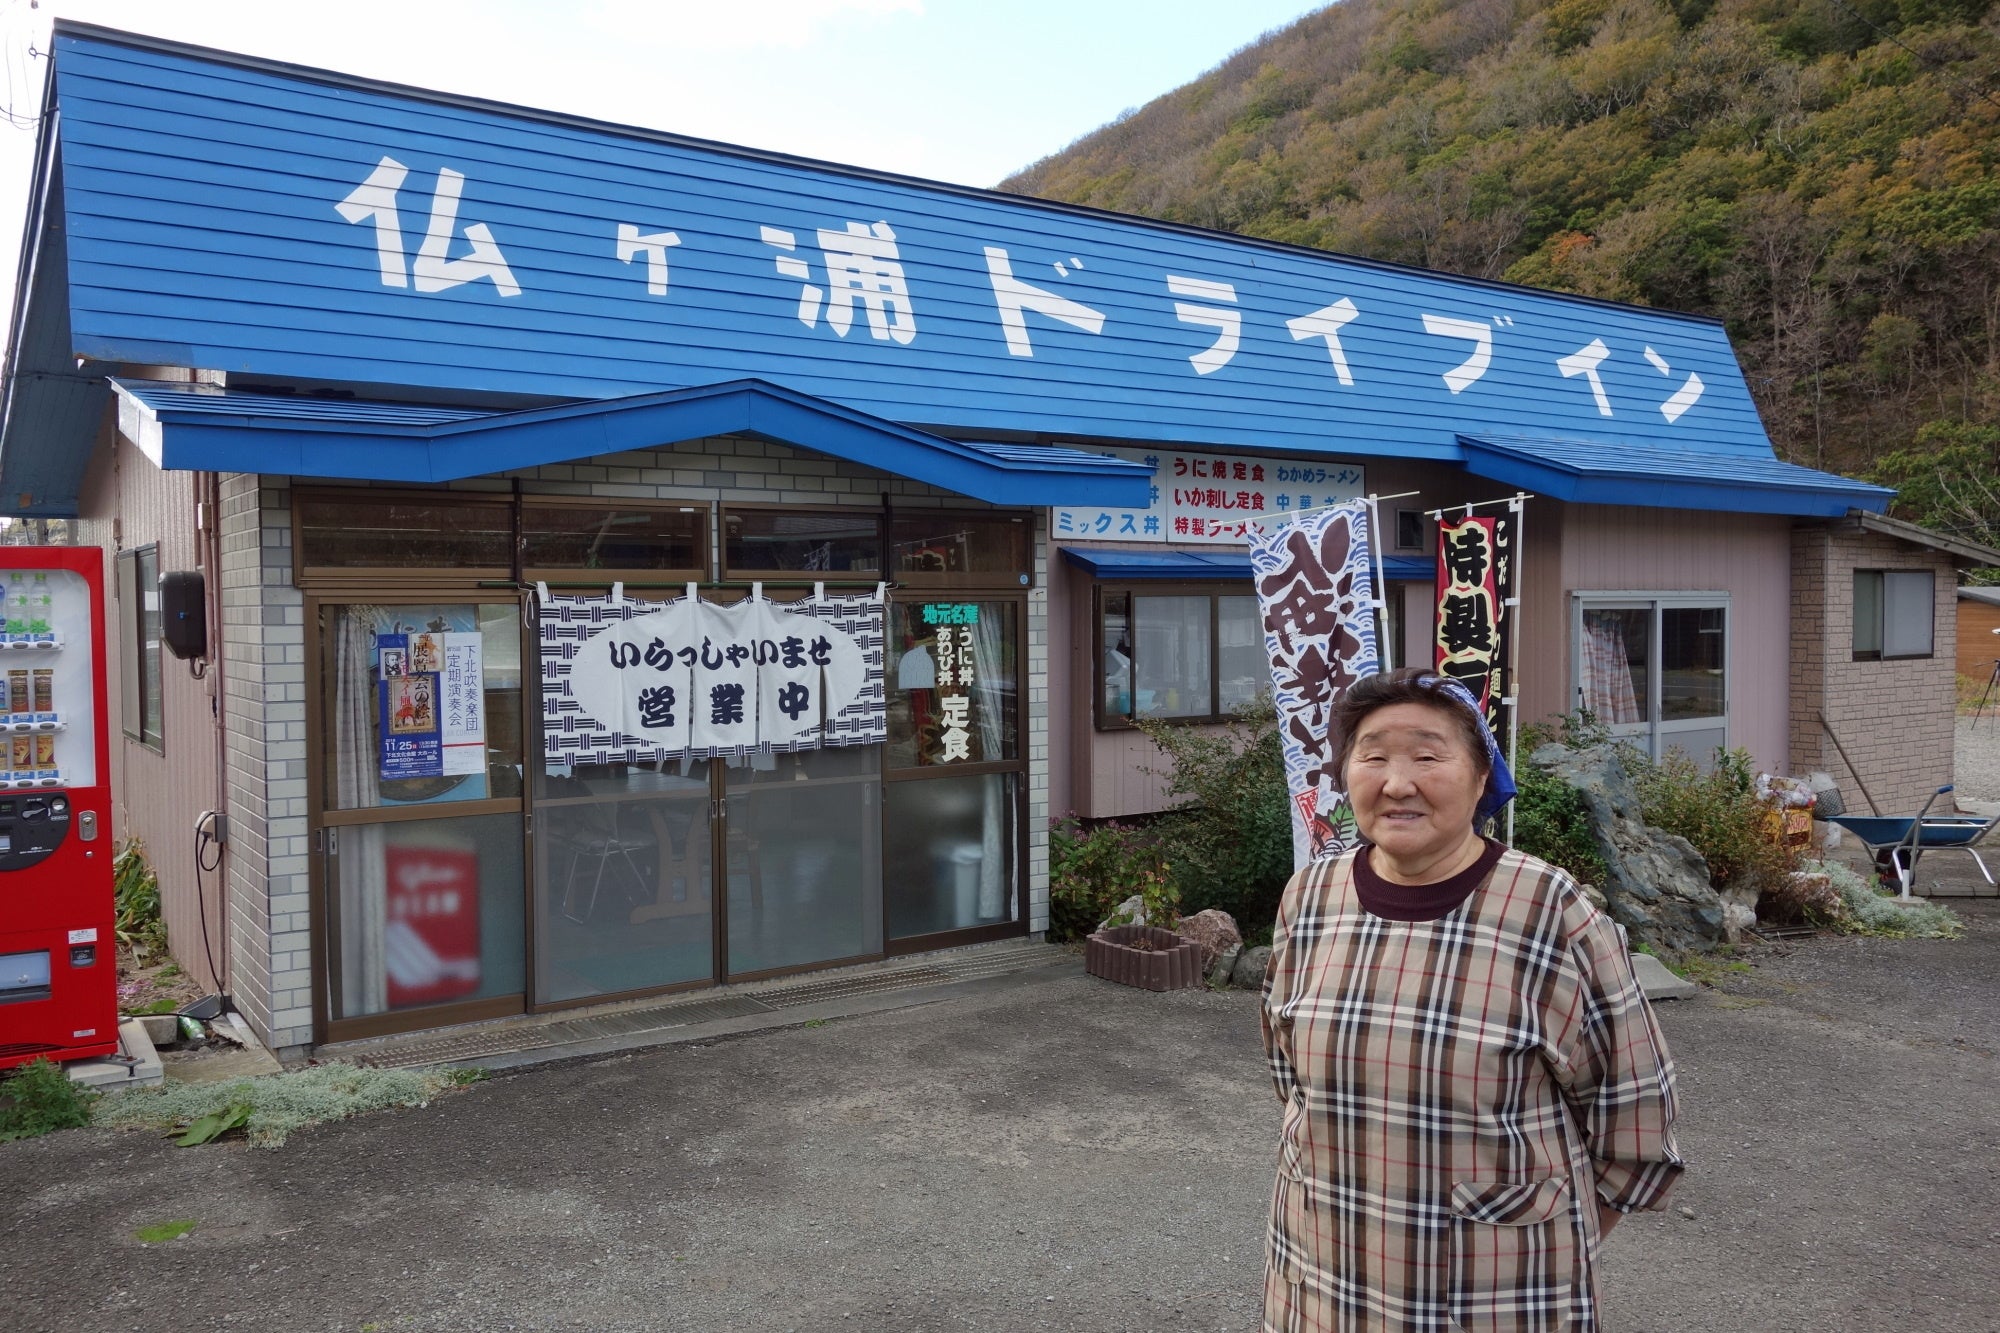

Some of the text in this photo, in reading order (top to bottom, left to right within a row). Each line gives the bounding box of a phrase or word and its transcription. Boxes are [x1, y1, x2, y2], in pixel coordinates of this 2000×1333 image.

[1173, 456, 1265, 482] うに焼定食
[1276, 466, 1361, 485] わかめラーメン
[1174, 487, 1265, 511] いか刺し定食
[1058, 511, 1160, 536] ミックス丼
[922, 603, 978, 625] 地元名産
[608, 635, 833, 671] いらっしゃいませ
[936, 626, 956, 687] あわび丼
[958, 626, 974, 687] うに丼
[446, 653, 463, 727] 定期演奏会
[464, 645, 478, 731] 下北吹奏楽団
[638, 681, 810, 728] 営業中
[941, 693, 970, 763] 定食
